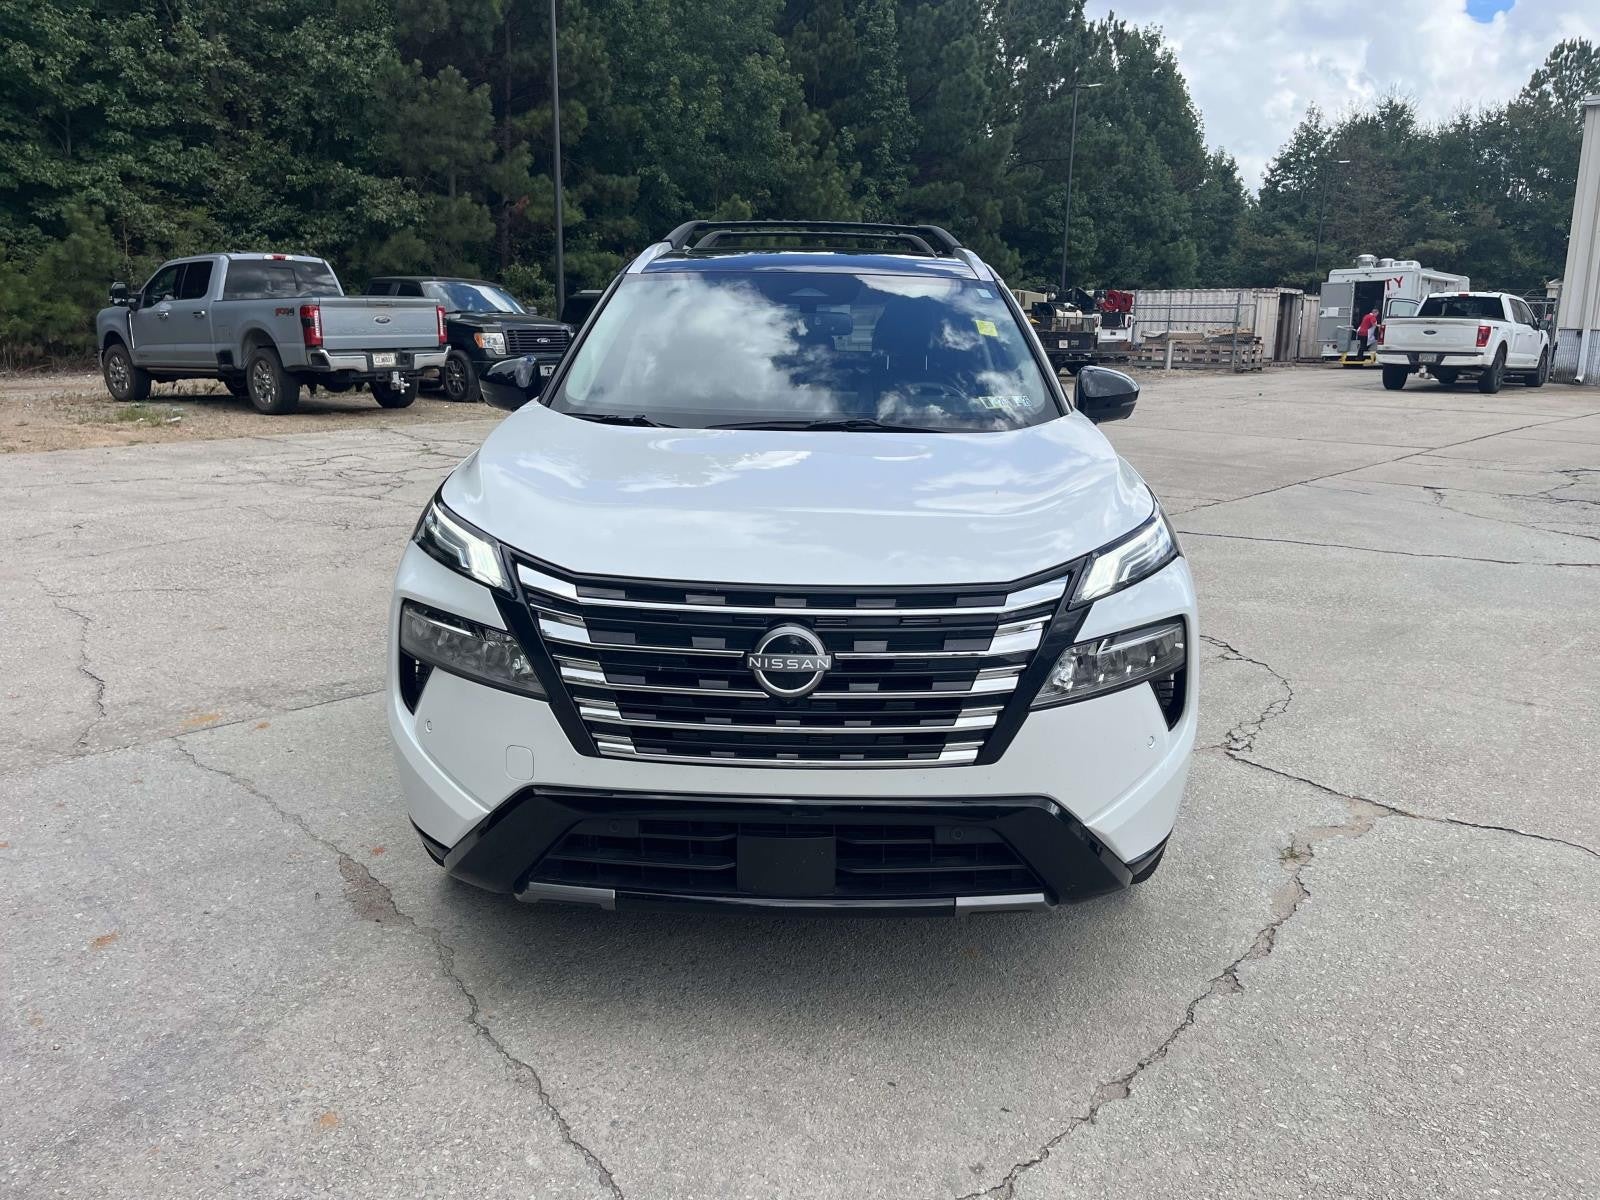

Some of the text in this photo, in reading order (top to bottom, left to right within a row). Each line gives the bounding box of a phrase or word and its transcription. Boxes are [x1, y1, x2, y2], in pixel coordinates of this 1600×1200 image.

[1386, 276, 1404, 290] TY
[544, 366, 552, 374] T
[749, 656, 829, 669] NISSAN
